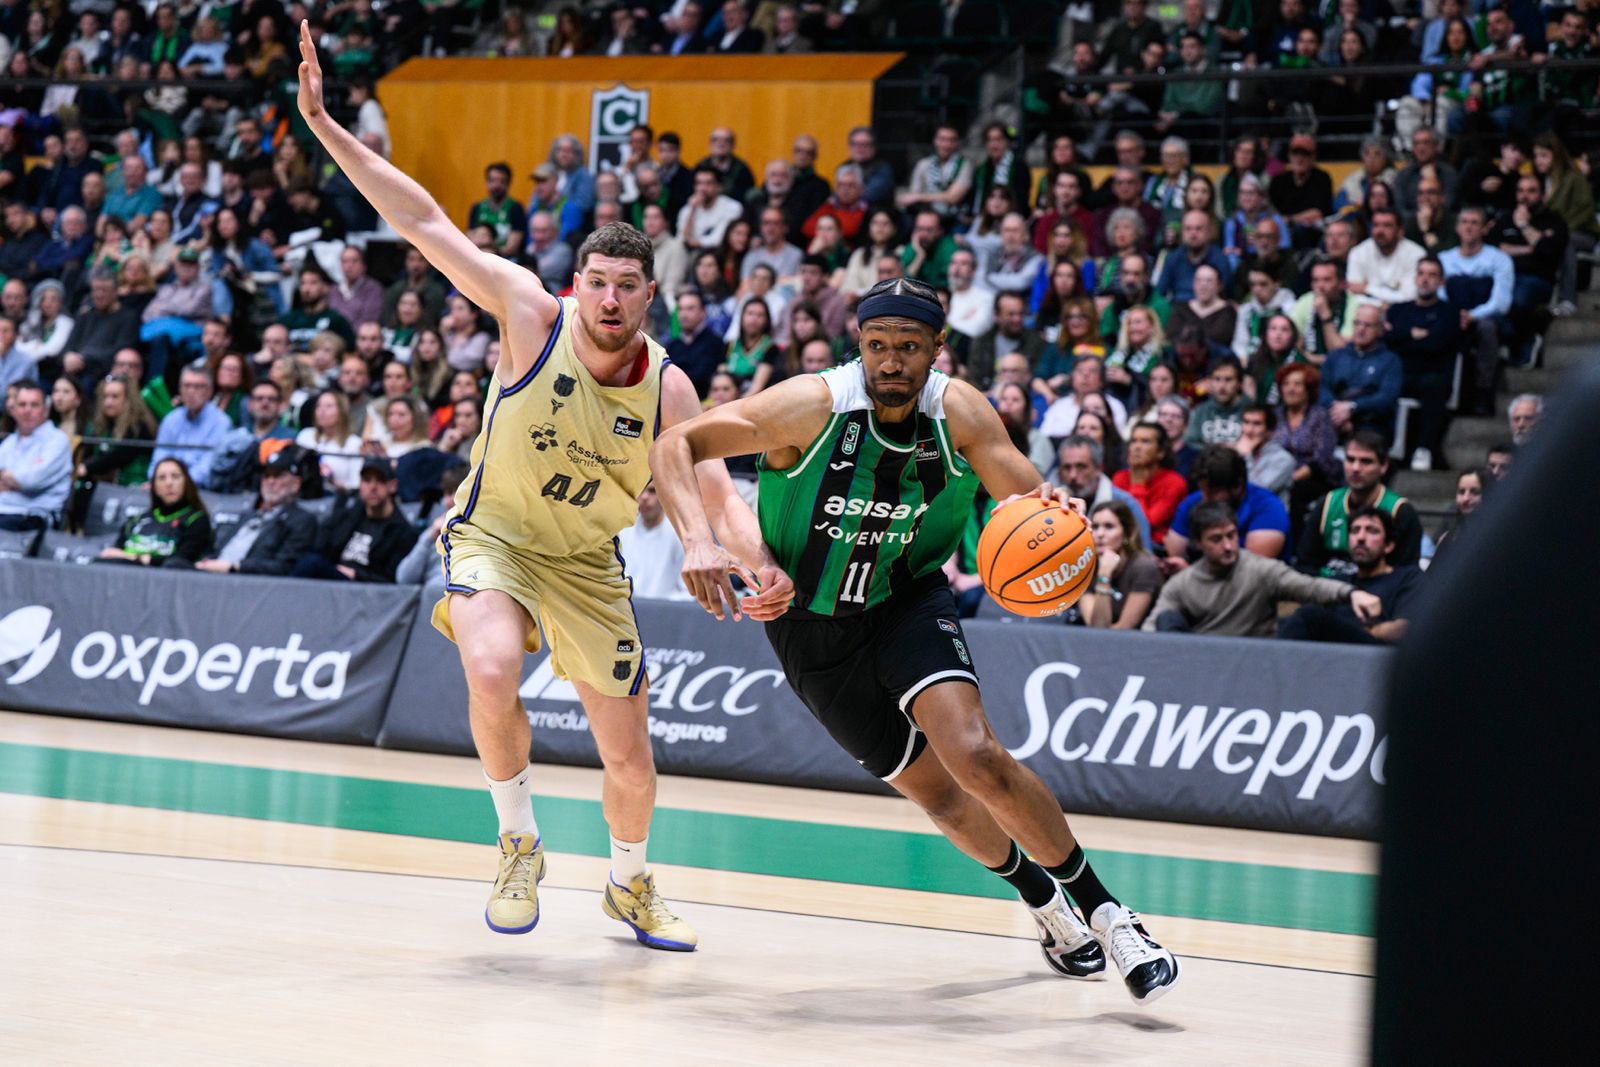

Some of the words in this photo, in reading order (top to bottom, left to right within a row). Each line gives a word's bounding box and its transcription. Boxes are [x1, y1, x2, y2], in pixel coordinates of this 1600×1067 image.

[541, 473, 600, 508] 44
[815, 521, 919, 545] JOVENTU
[1027, 527, 1055, 550] acb
[840, 562, 871, 604] 11
[1026, 546, 1093, 596] Wilson
[70, 630, 352, 706] oxperta
